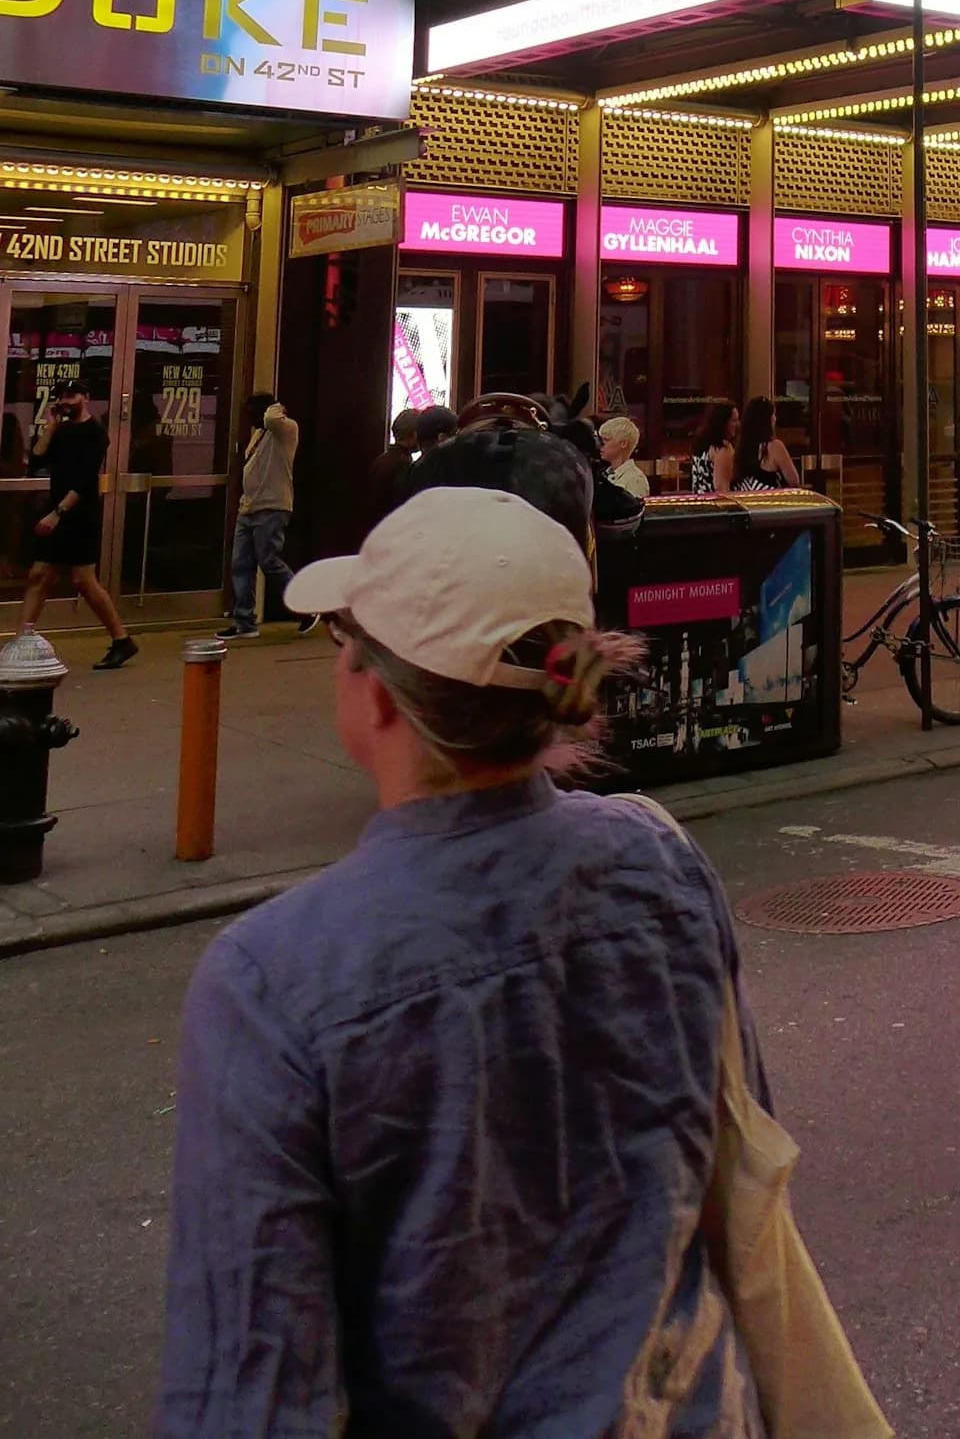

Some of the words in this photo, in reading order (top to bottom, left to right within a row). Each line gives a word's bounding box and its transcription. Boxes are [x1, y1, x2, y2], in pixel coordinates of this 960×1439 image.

[200, 53, 246, 76] ON
[254, 60, 321, 82] 42ND
[327, 68, 366, 89] ST
[305, 212, 354, 235] PRIMARY
[357, 206, 392, 226] STAGES
[451, 204, 510, 225] EWAN
[420, 222, 537, 246] McGREGOR
[628, 217, 694, 237] MAGGIE
[791, 226, 856, 246] CYNTHIA
[6, 233, 64, 261] 42ND
[69, 236, 143, 264] STREET
[147, 240, 229, 268] STUDIOS
[603, 236, 719, 256] GYLLENHAAL
[794, 244, 851, 263] NIXON
[36, 363, 56, 378] NEW
[57, 363, 80, 378] 42ND
[163, 365, 181, 380] NEW
[182, 365, 204, 380] 42ND
[160, 386, 202, 425] 229
[633, 587, 686, 603] MIDNIGHT
[689, 582, 735, 598] MOMENT
[631, 737, 657, 750] TSAC
